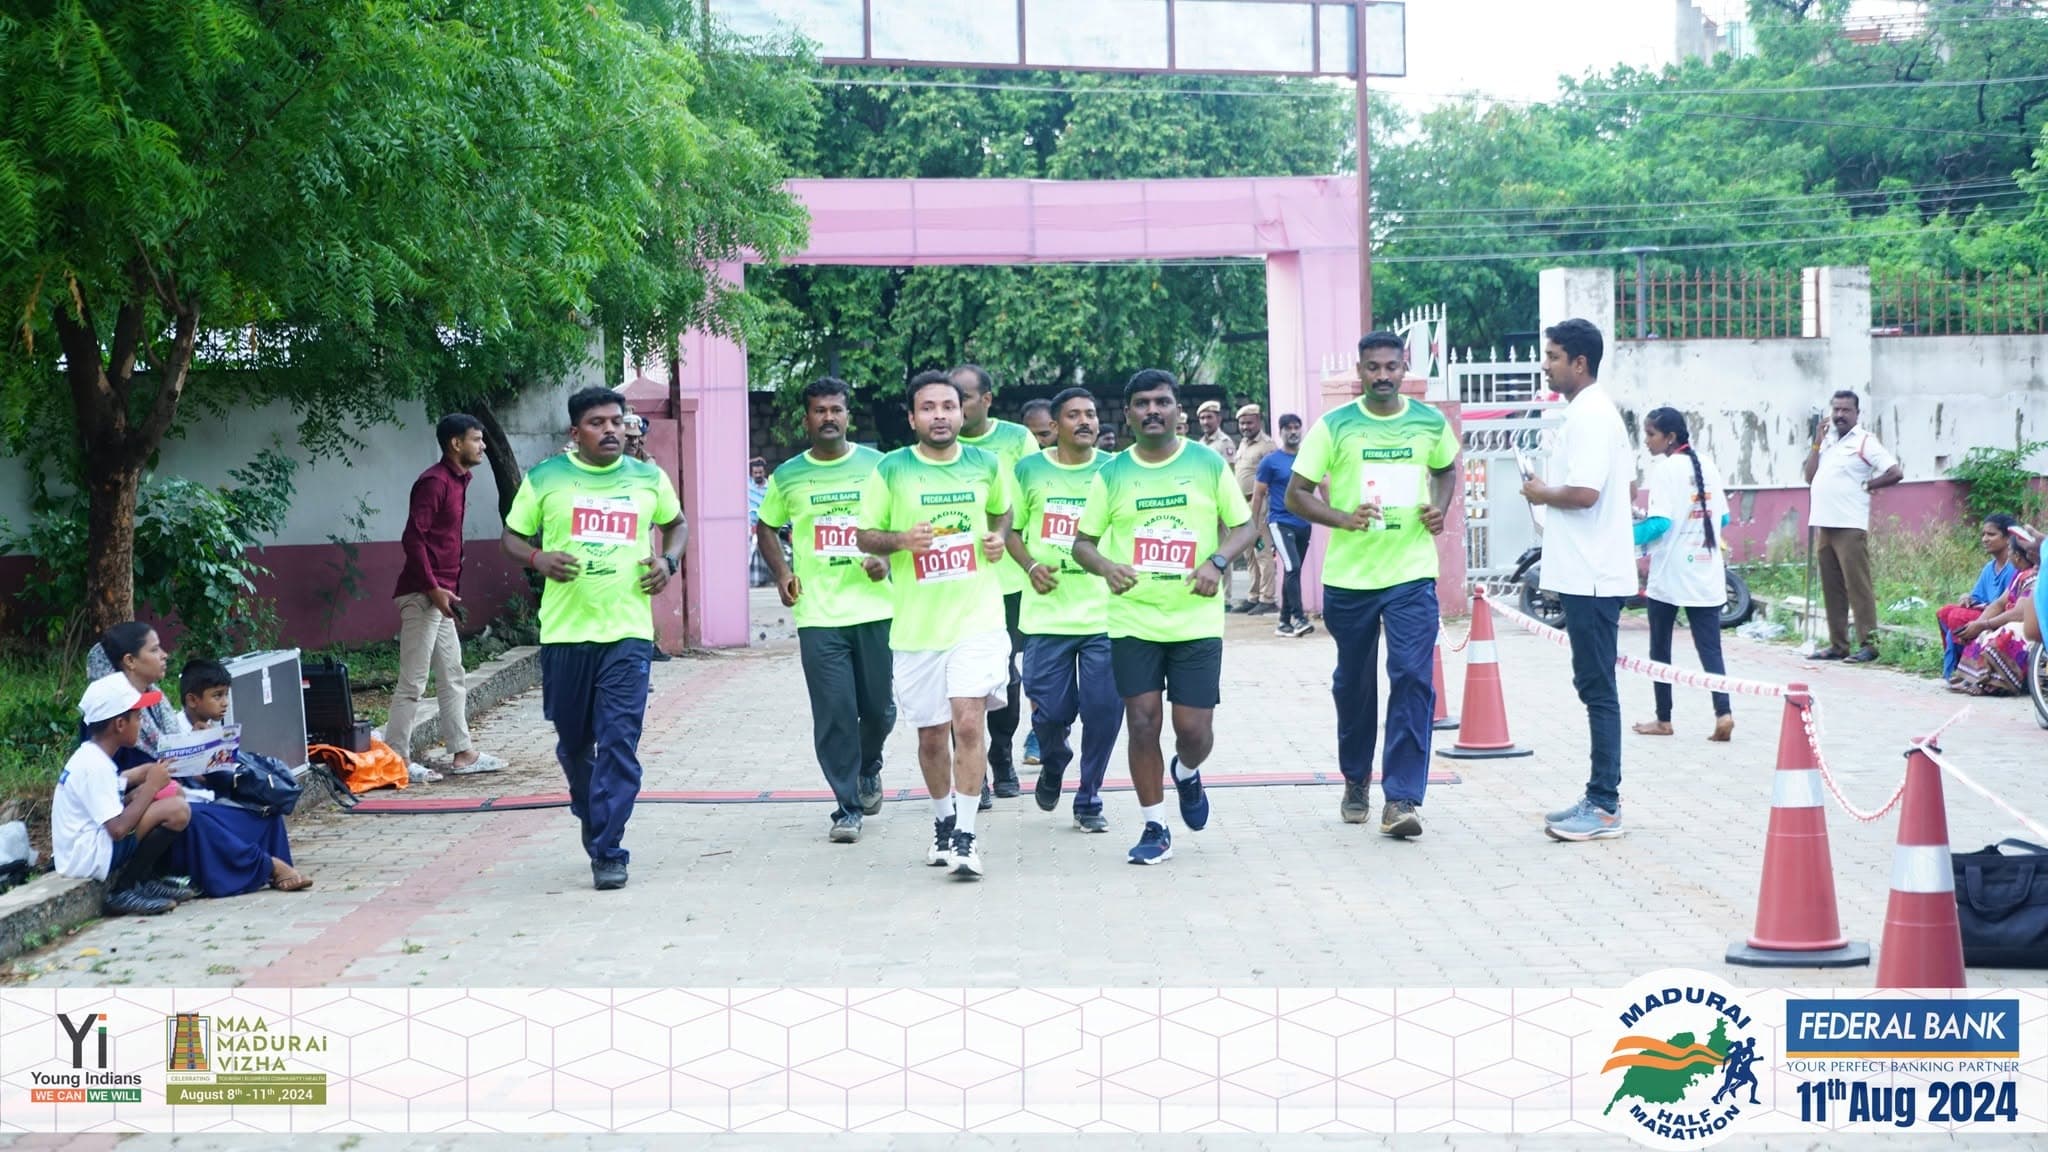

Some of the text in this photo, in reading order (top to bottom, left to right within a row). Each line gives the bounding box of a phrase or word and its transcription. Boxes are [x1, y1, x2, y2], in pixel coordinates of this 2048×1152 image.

[578, 512, 630, 534] 10111
[820, 530, 857, 546] 1016
[919, 549, 970, 573] 10109
[1140, 543, 1191, 563] 10107
